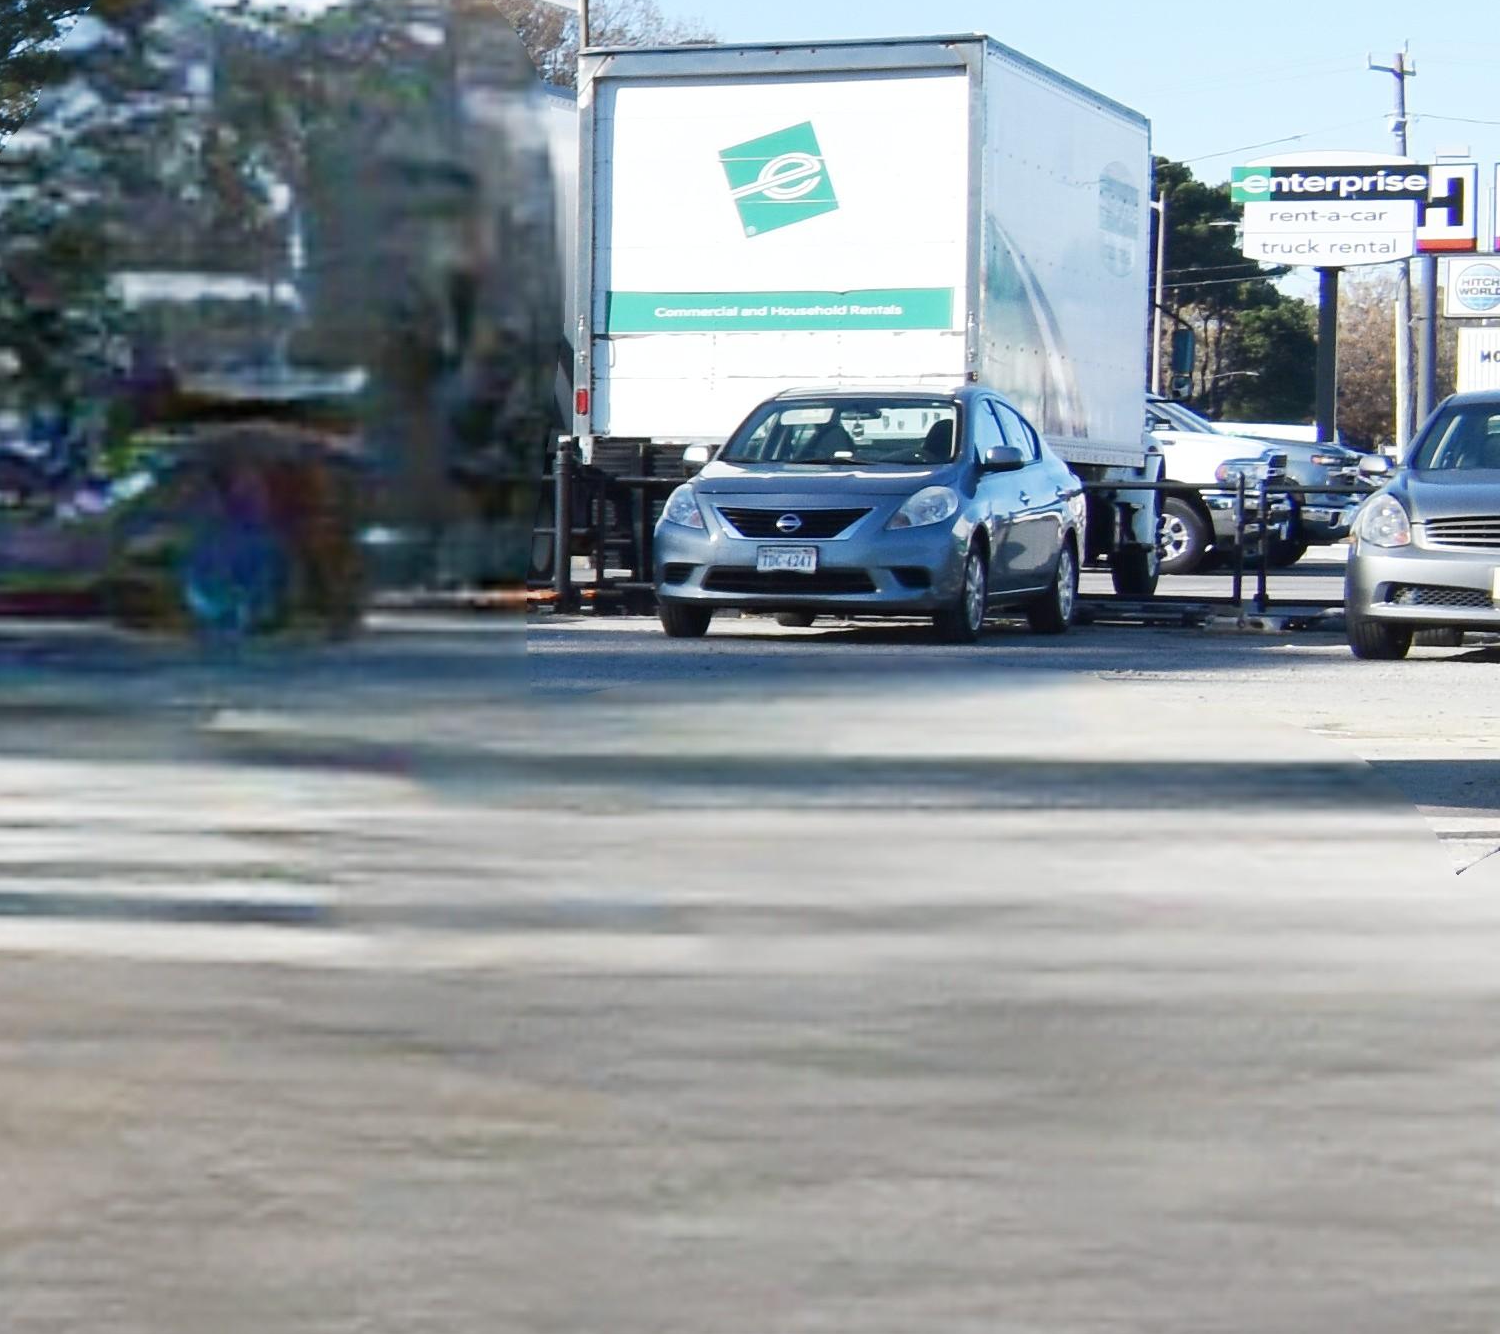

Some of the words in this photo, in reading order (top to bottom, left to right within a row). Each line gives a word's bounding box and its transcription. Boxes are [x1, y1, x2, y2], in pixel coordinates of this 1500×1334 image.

[1243, 170, 1427, 197] enterprise
[1269, 209, 1388, 222] rent-a-car
[1261, 238, 1319, 254] truck
[1329, 238, 1397, 254] rental
[1462, 277, 1500, 286] HITCH
[1459, 287, 1500, 295] WORLD
[654, 306, 737, 318] Commercial
[741, 305, 767, 317] and
[770, 305, 847, 316] Household
[850, 304, 903, 316] Rentals
